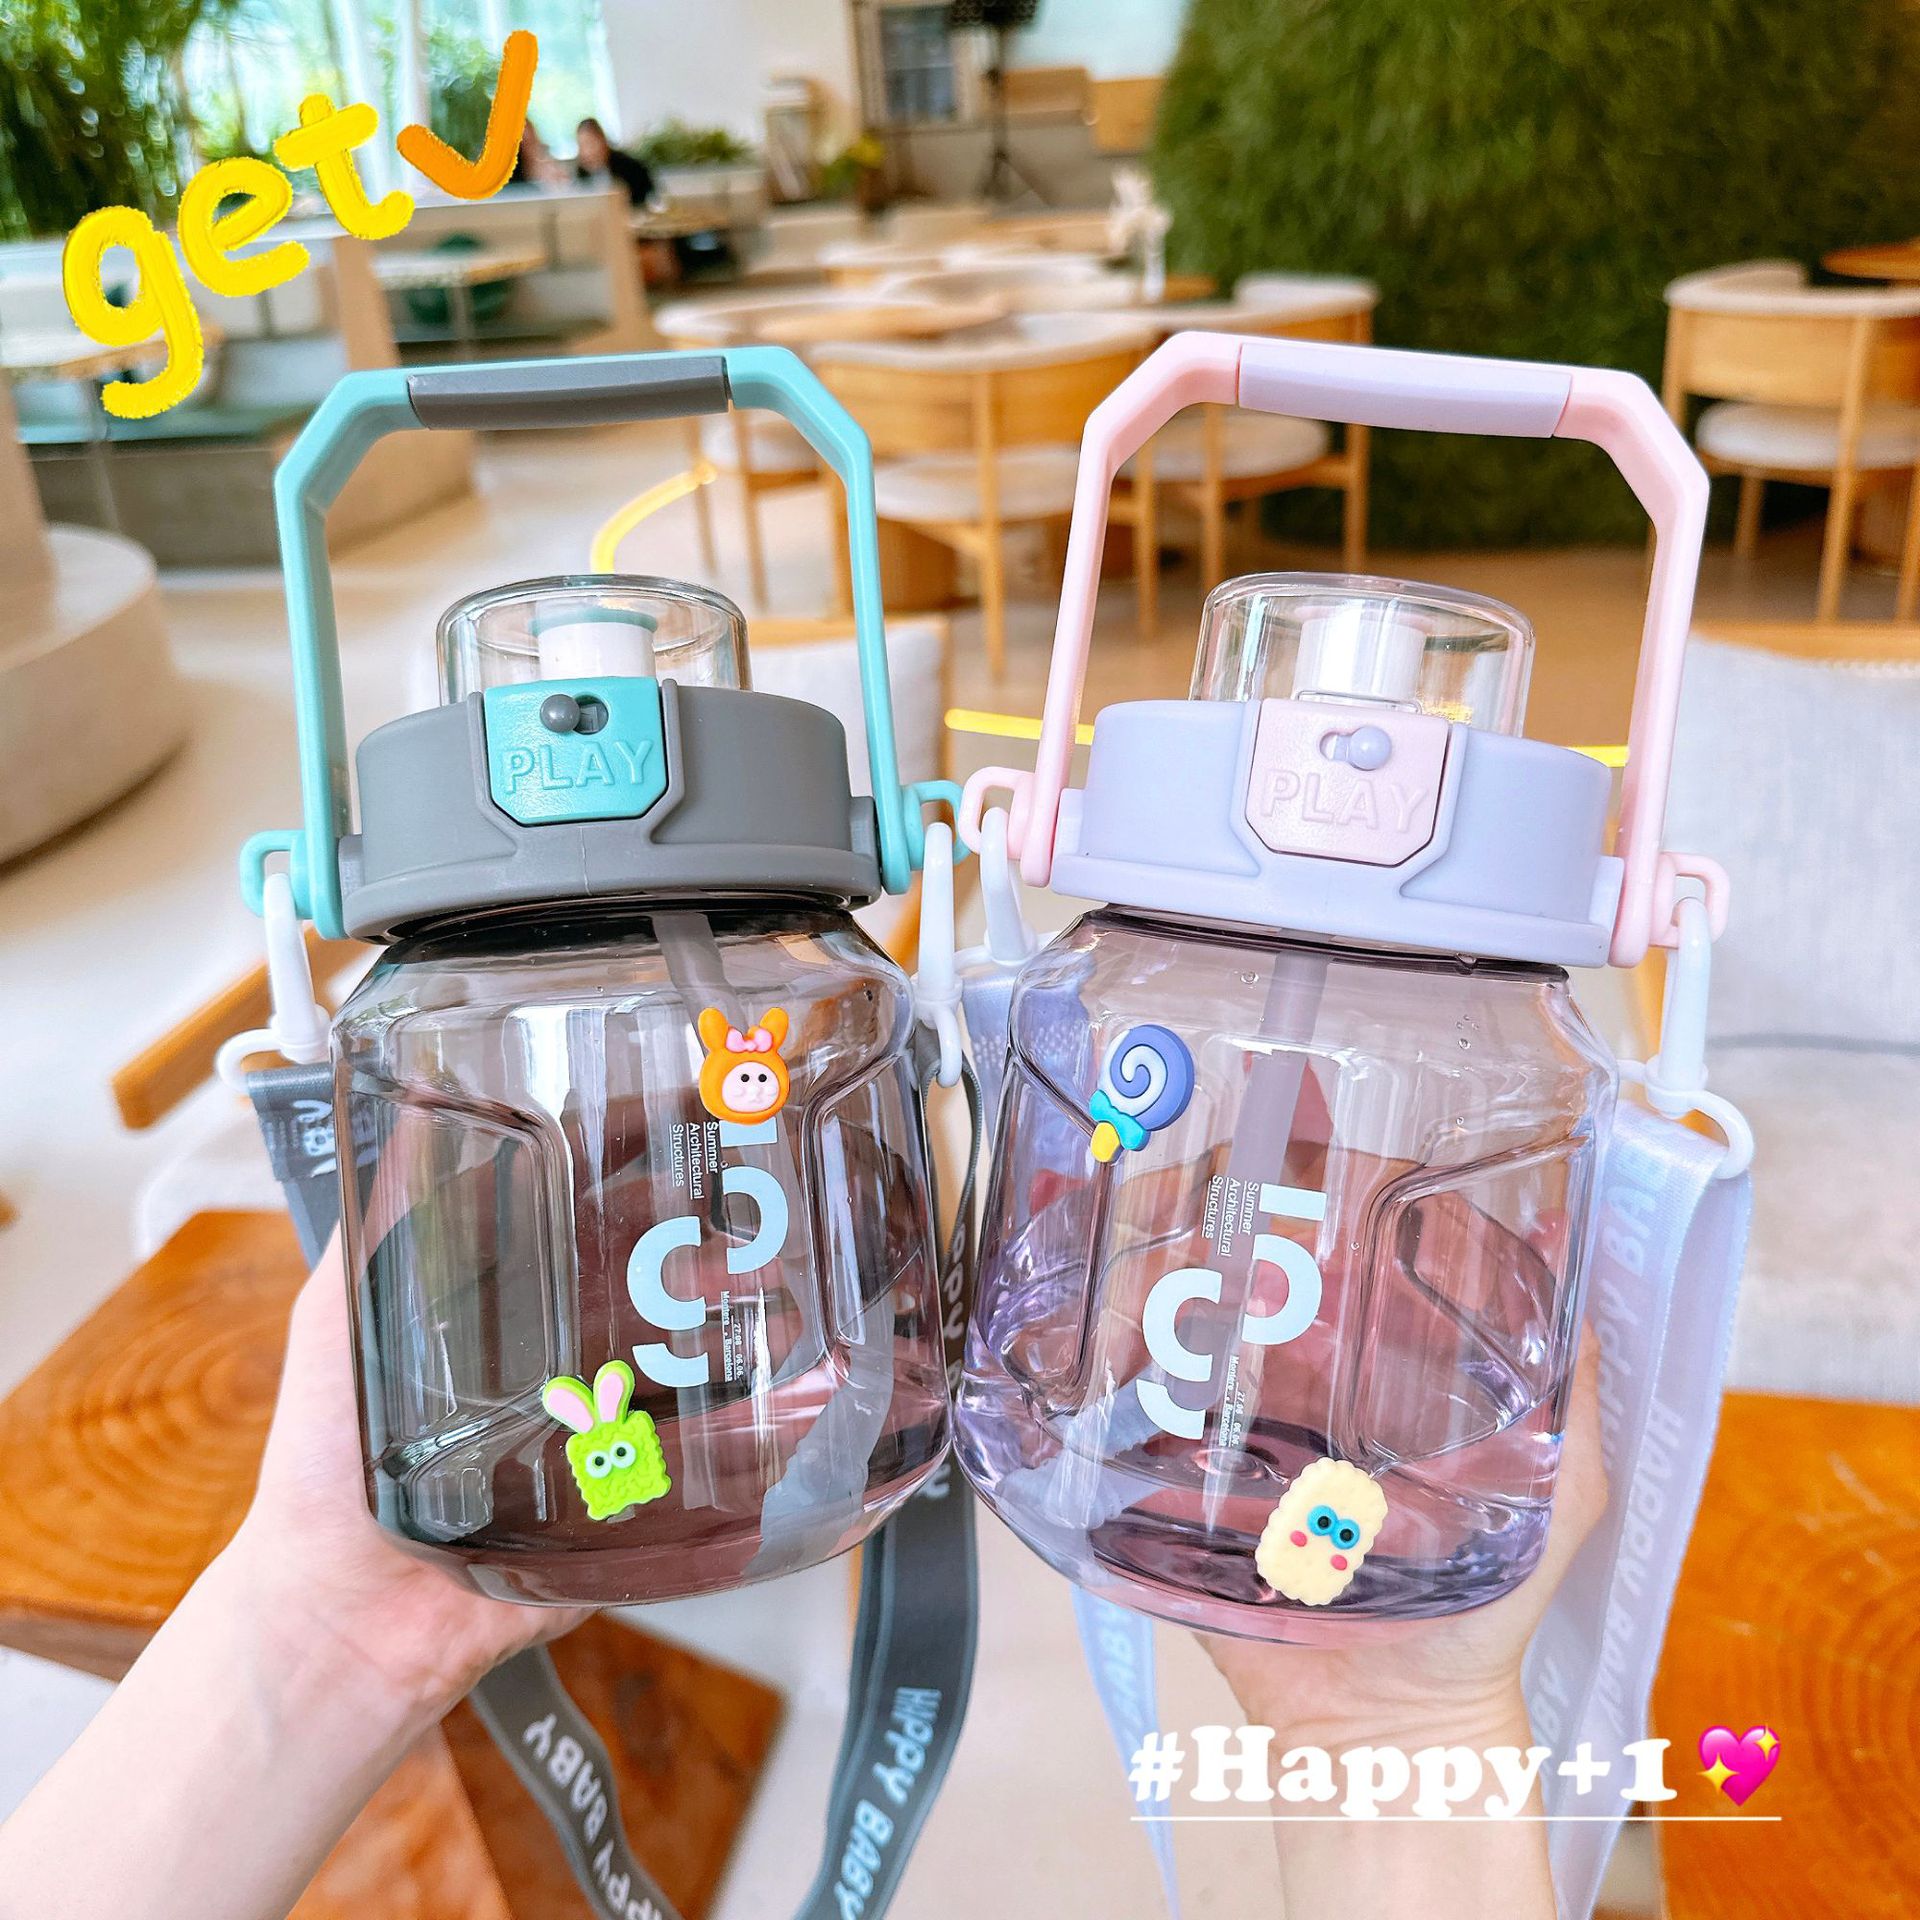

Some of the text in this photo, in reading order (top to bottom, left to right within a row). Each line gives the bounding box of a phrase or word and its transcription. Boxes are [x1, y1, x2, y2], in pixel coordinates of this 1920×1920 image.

[504, 740, 653, 795] PLAY
[1260, 768, 1429, 834] PLAY
[671, 1123, 685, 1187] Structures
[689, 1122, 705, 1200] Architectural
[705, 1121, 719, 1174] Summer
[1204, 1174, 1224, 1239] Structures
[1220, 1177, 1241, 1257] Architectural
[1241, 1181, 1260, 1236] Summer
[522, 1712, 609, 1840] BABY
[834, 1800, 895, 1920] BABY
